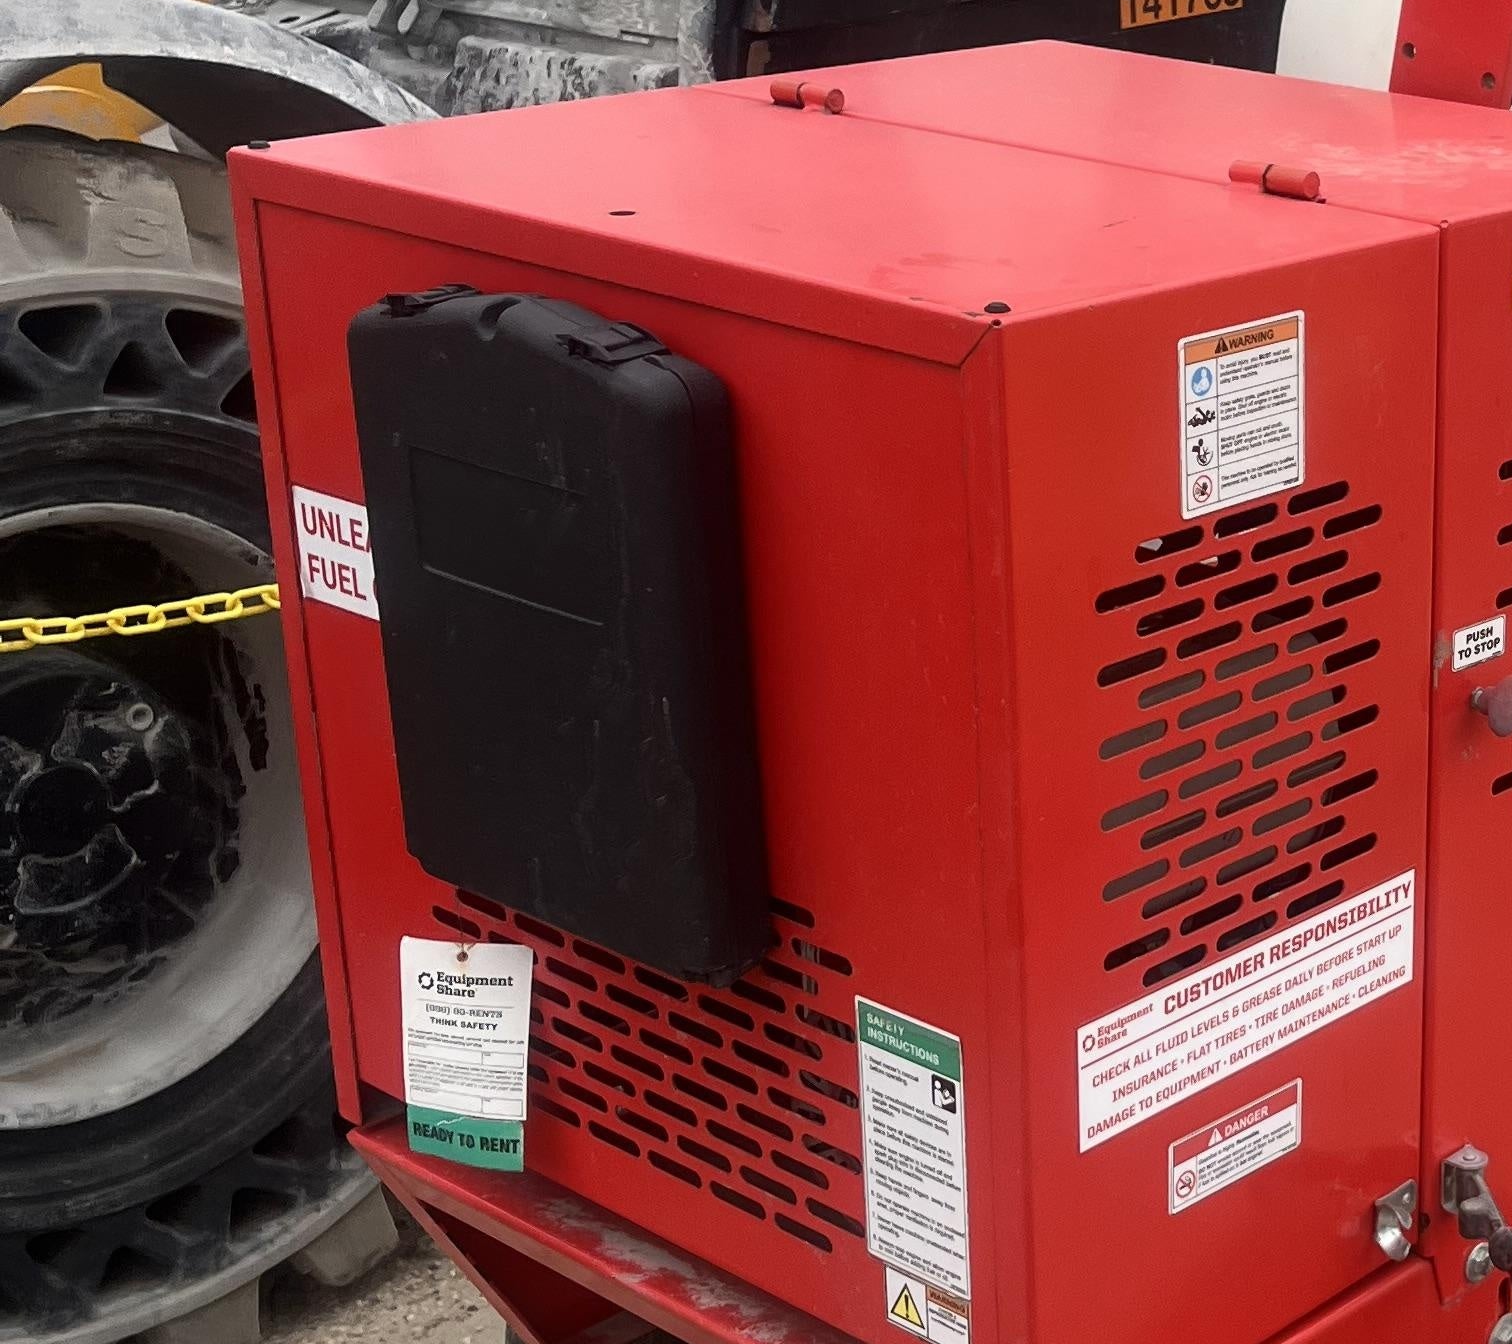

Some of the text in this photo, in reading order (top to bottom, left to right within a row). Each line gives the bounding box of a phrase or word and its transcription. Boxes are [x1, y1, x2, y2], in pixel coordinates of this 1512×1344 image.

[1229, 328, 1274, 349] WARNING
[301, 502, 372, 553] UNLE
[307, 552, 367, 601] FUEL
[1458, 637, 1501, 661] TO STOP
[1466, 626, 1493, 645] PUSH
[1164, 880, 1411, 1015] CUSTOMER RESPONSIBILITY
[436, 971, 513, 988] Equipment
[436, 984, 476, 998] Share
[1092, 1058, 1130, 1088] CHECK
[1133, 1049, 1152, 1067] ALL
[1155, 1031, 1189, 1056] FLUID
[1191, 1010, 1230, 1038] LEVELS
[1242, 982, 1282, 1013] GREASE
[1285, 966, 1314, 992] DAILY
[1317, 948, 1354, 976] BEFORE
[1356, 931, 1386, 956] START
[1389, 924, 1402, 940] UP
[1097, 1003, 1154, 1038] Equipment
[430, 1016, 498, 1031] THINK SAFETY
[866, 1011, 906, 1037] SAFETY
[1097, 1028, 1128, 1049] Share
[1112, 954, 1386, 1103] INSURANCE FLAT TIRES TIRE DAMAGE REFUELING
[867, 1027, 939, 1067] INSTRUCTIONS
[1087, 965, 1406, 1139] DAMAGE TO EQUIPMENT BATTERY MAINTENANCE CLEANING
[1224, 1105, 1268, 1137] DANGER
[413, 1121, 520, 1154] READY TO RENT
